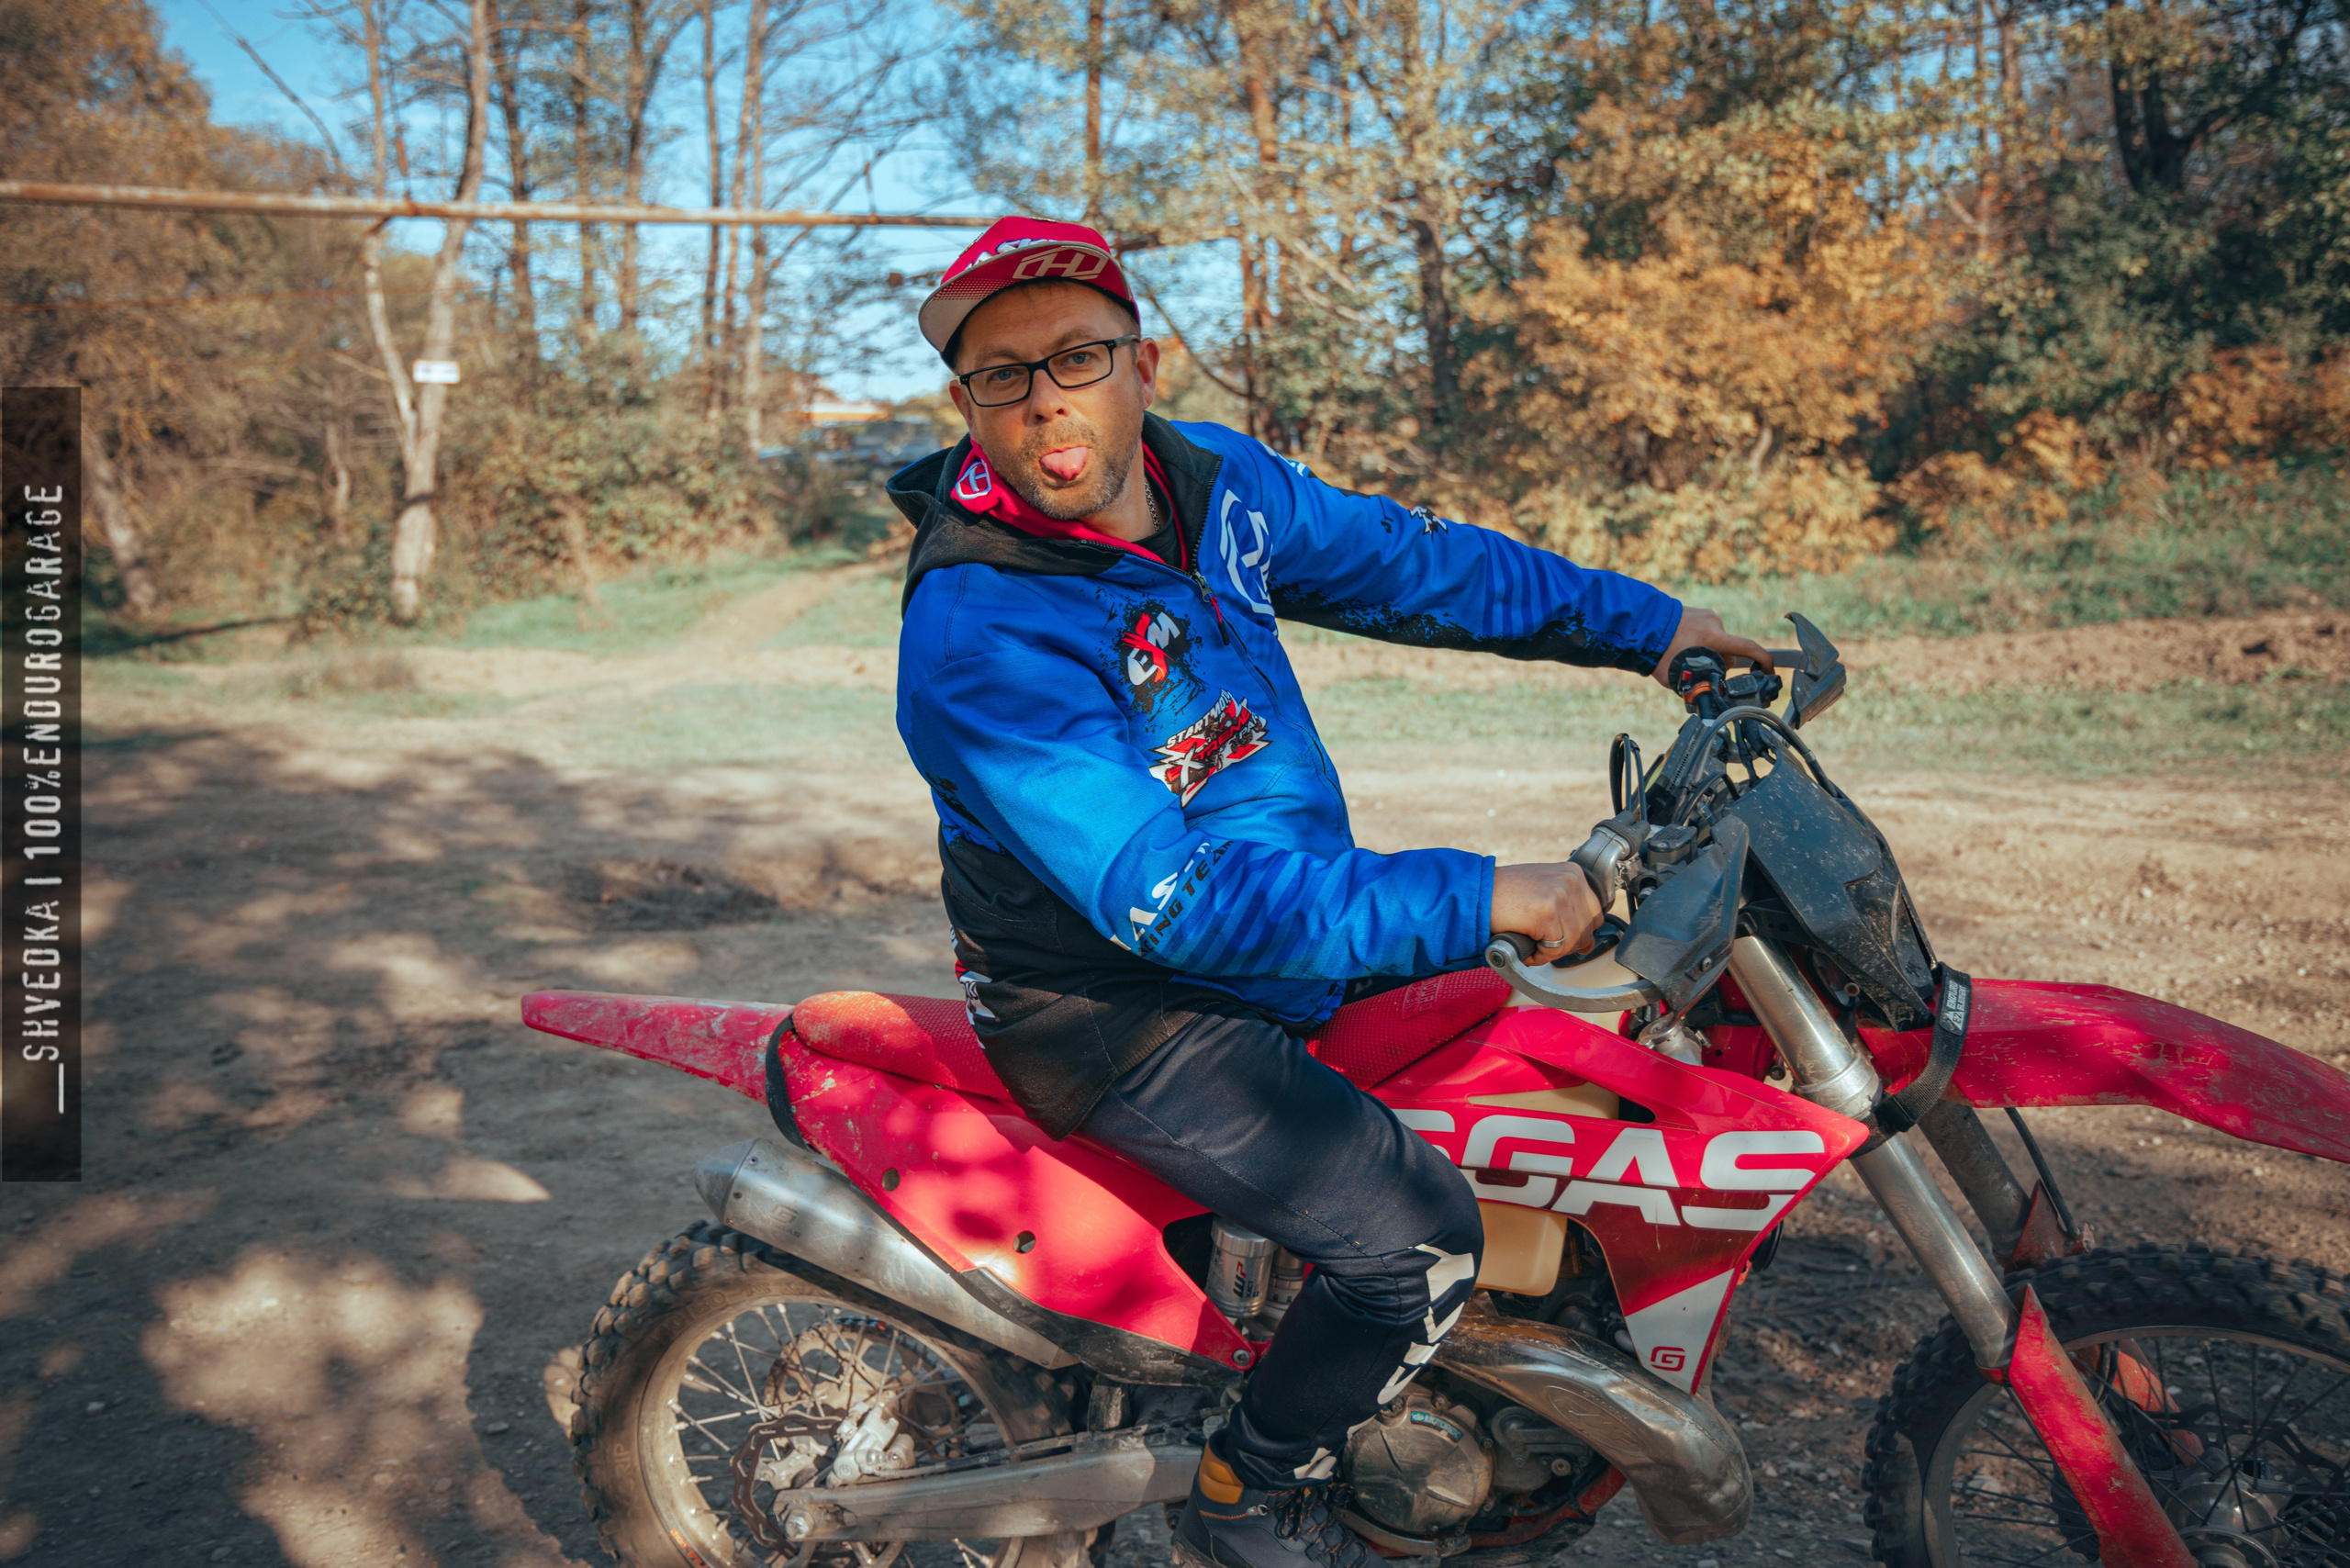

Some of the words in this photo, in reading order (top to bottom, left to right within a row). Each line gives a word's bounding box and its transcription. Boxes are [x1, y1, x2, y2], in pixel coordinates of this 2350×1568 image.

[1165, 706, 1251, 790] EXTREME
[1181, 840, 1235, 897] TEAM
[1424, 1414, 1460, 1439] MOTOREX
